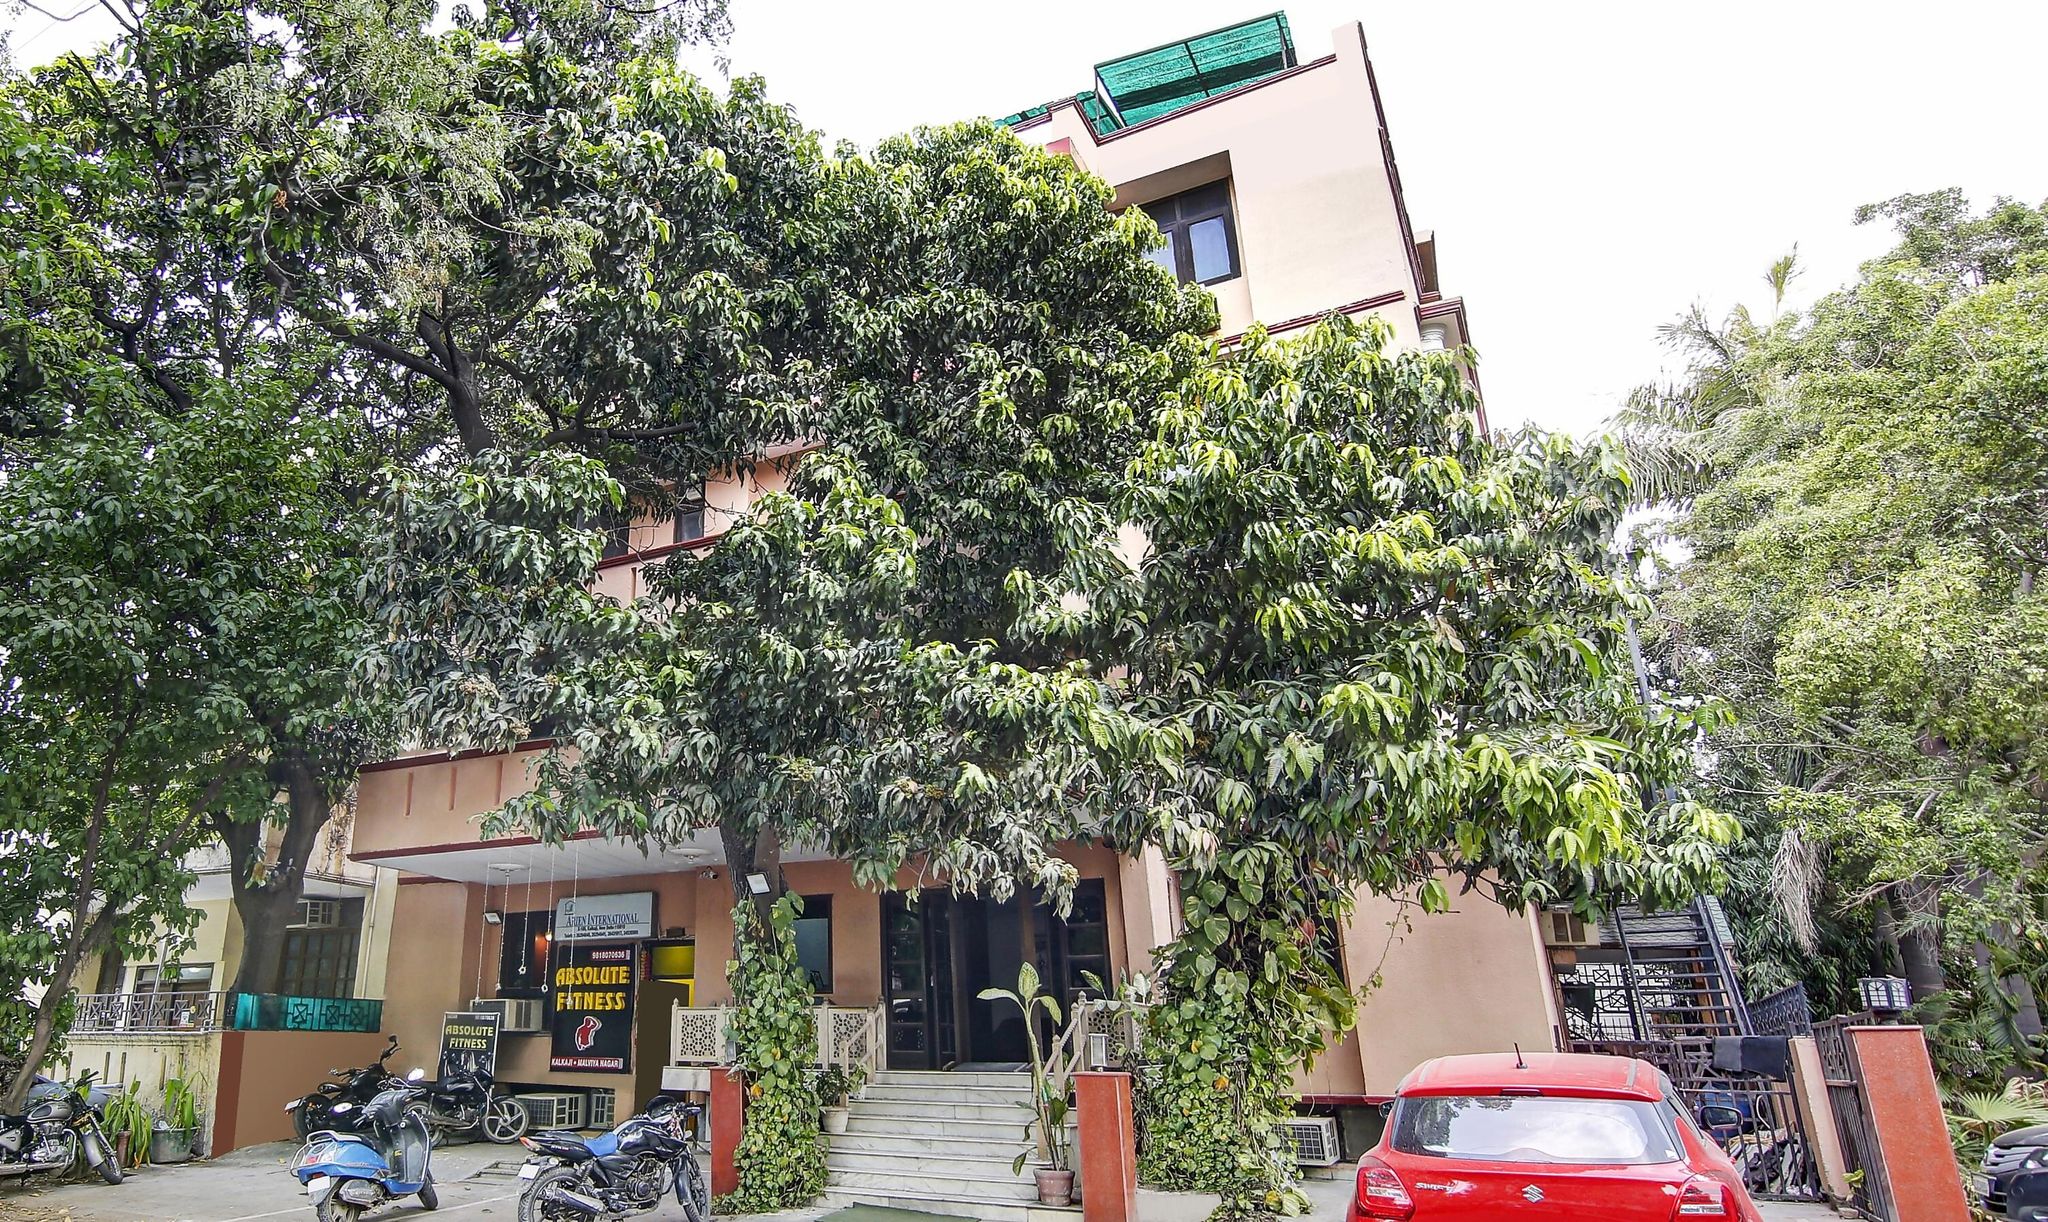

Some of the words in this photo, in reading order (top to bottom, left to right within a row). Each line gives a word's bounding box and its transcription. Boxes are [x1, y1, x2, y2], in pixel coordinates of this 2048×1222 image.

[556, 966, 630, 987] ABSOLUTE
[445, 1025, 494, 1036] ABSOLUTE
[449, 1038, 487, 1049] FITNESS
[551, 1058, 573, 1066] KALKAJI
[577, 1059, 599, 1067] MALVIYA
[600, 1060, 619, 1068] NAGAR
